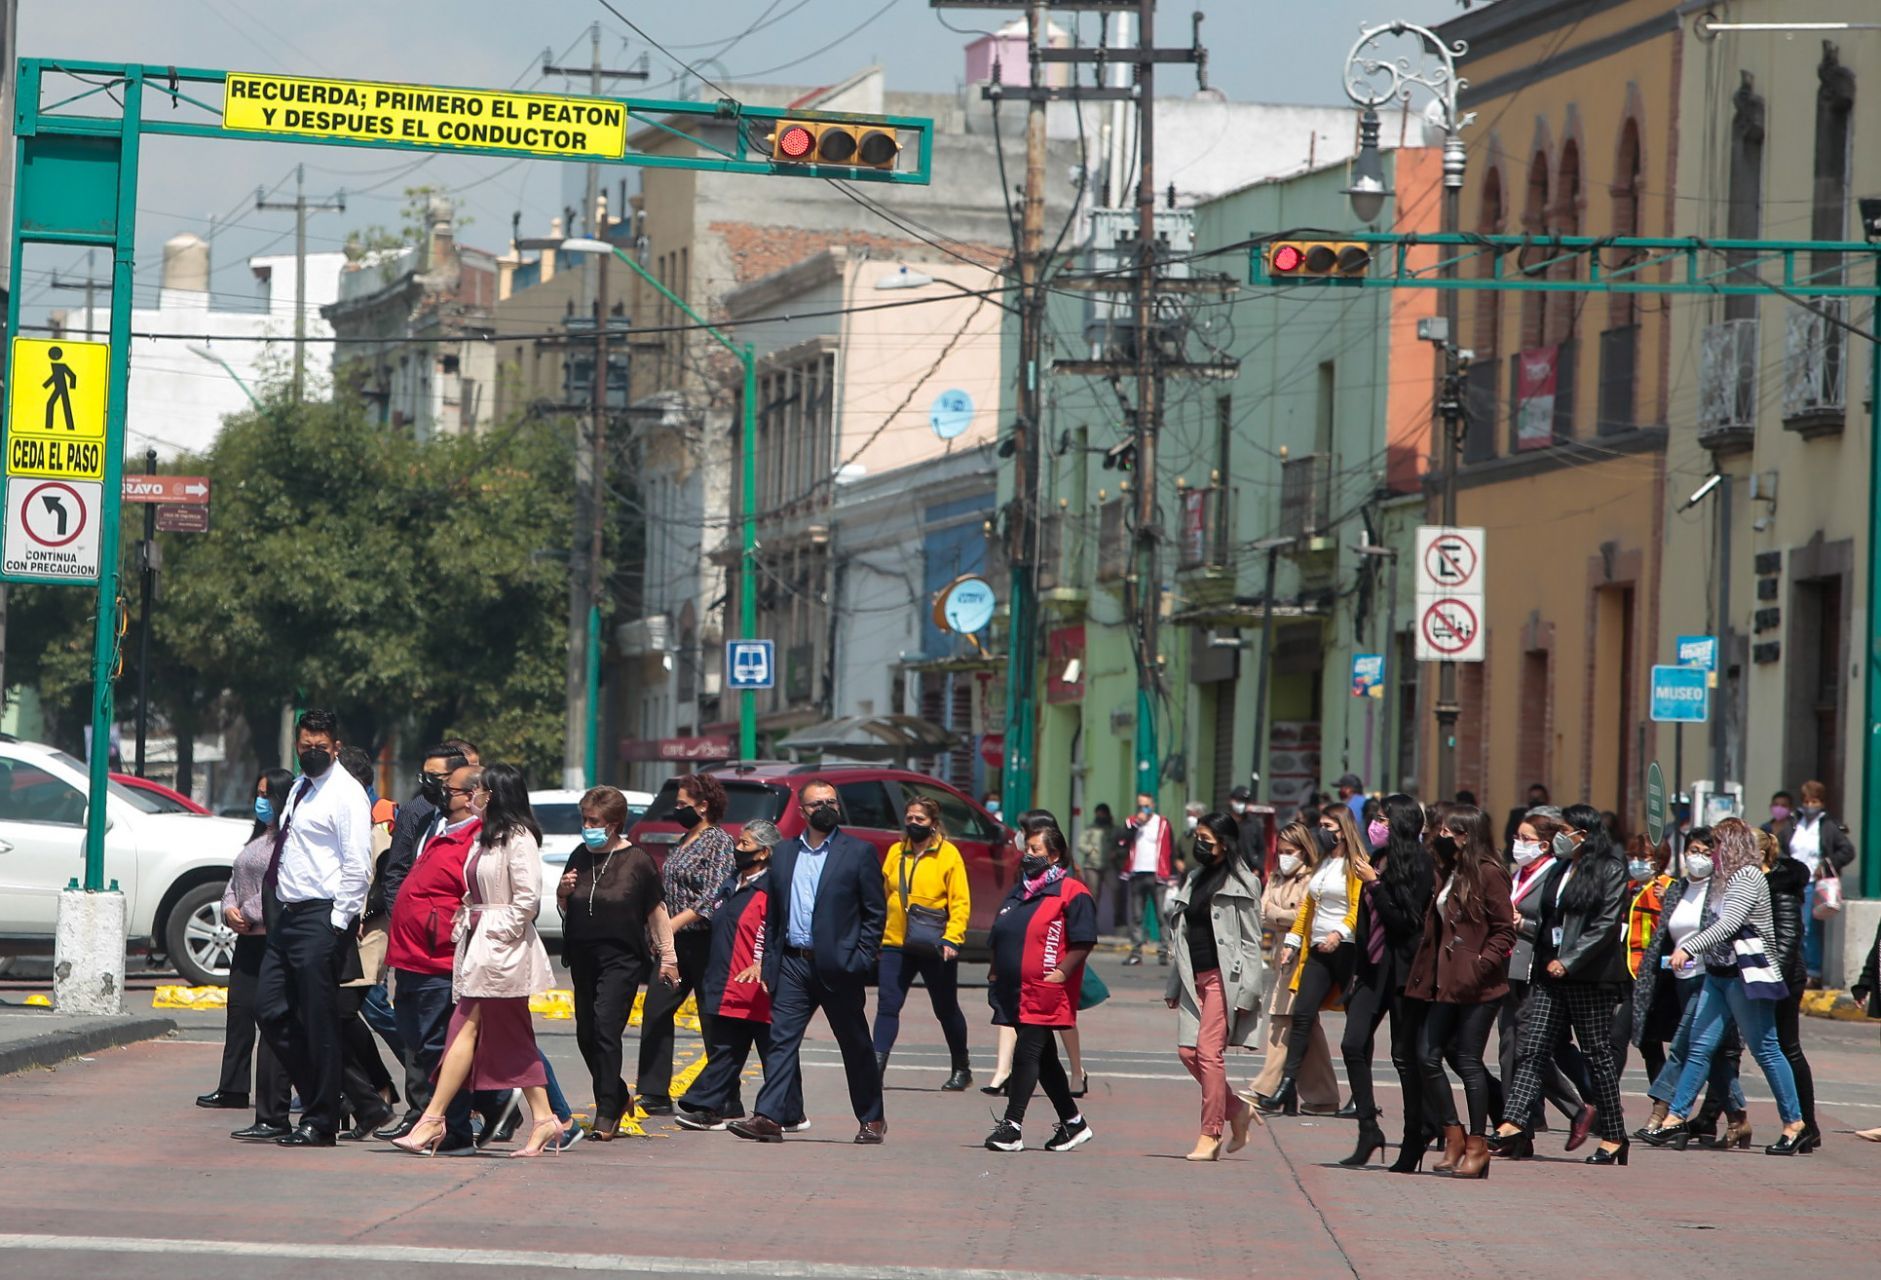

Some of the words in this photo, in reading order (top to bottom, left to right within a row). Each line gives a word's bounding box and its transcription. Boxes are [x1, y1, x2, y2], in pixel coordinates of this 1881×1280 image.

[231, 79, 367, 111] RECUERDA;
[375, 90, 484, 116] PRIMERO
[491, 99, 519, 119] EL
[526, 102, 620, 127] PEATON
[262, 107, 278, 126] Y
[284, 109, 394, 135] DESPUES
[402, 119, 429, 138] EL
[437, 121, 587, 150] CONDUCTOR
[13, 439, 45, 469] CEDA
[49, 441, 63, 471] EL
[67, 443, 99, 473] PASO
[6, 560, 28, 571] CON
[30, 562, 95, 575] PRECAUCION
[26, 550, 77, 563] CONTINUA
[1655, 686, 1704, 701] MUSEO
